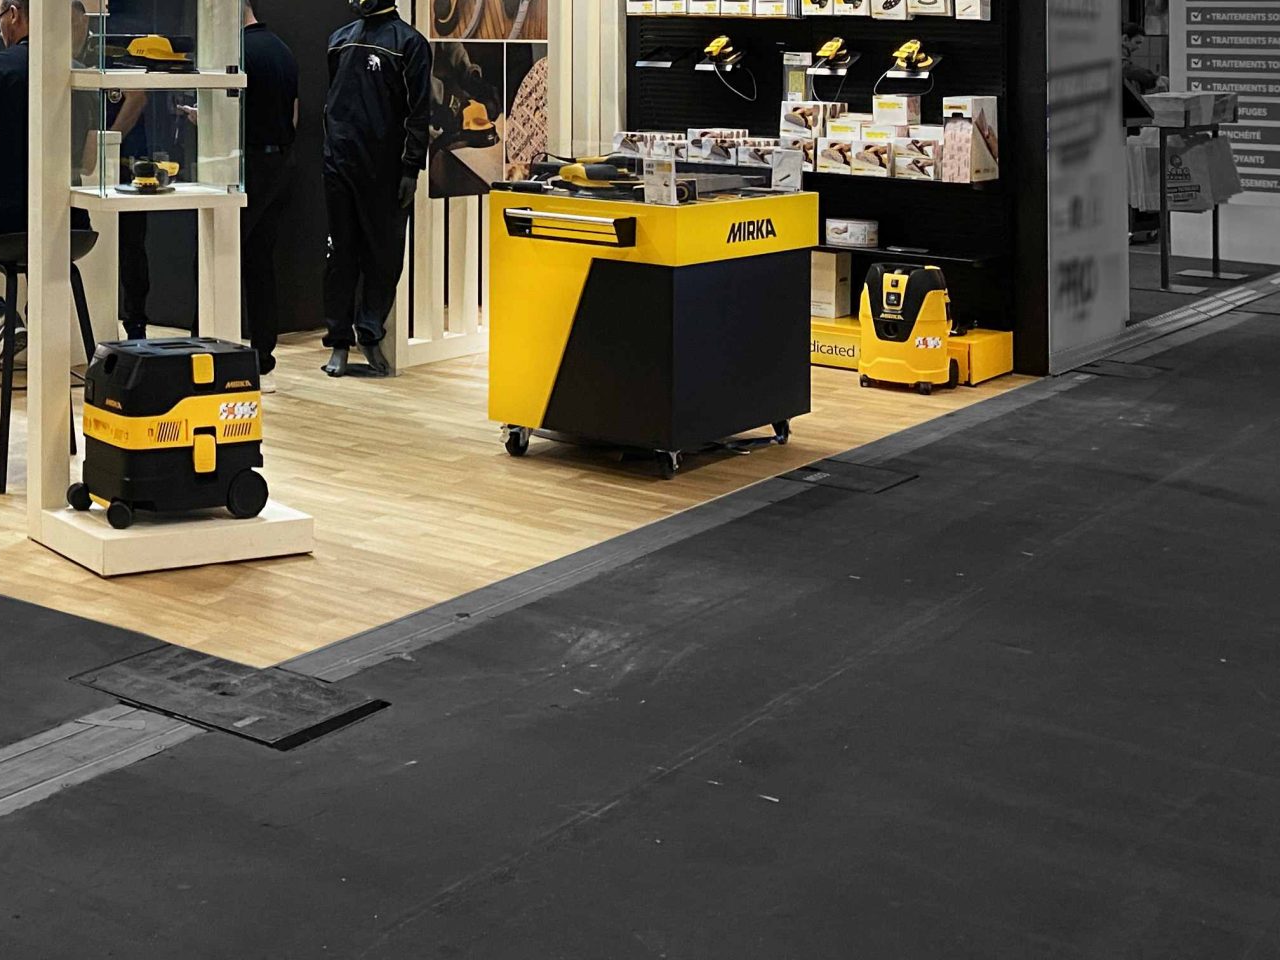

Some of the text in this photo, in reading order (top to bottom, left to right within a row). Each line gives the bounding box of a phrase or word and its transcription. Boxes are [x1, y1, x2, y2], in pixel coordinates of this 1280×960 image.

[1211, 12, 1267, 21] TRAITEMENTS
[1211, 36, 1267, 45] TRAITEMENTS
[1211, 59, 1267, 69] TRAITEMENTS
[1212, 83, 1267, 93] TRAITEMENTS
[726, 218, 777, 244] MIRKA
